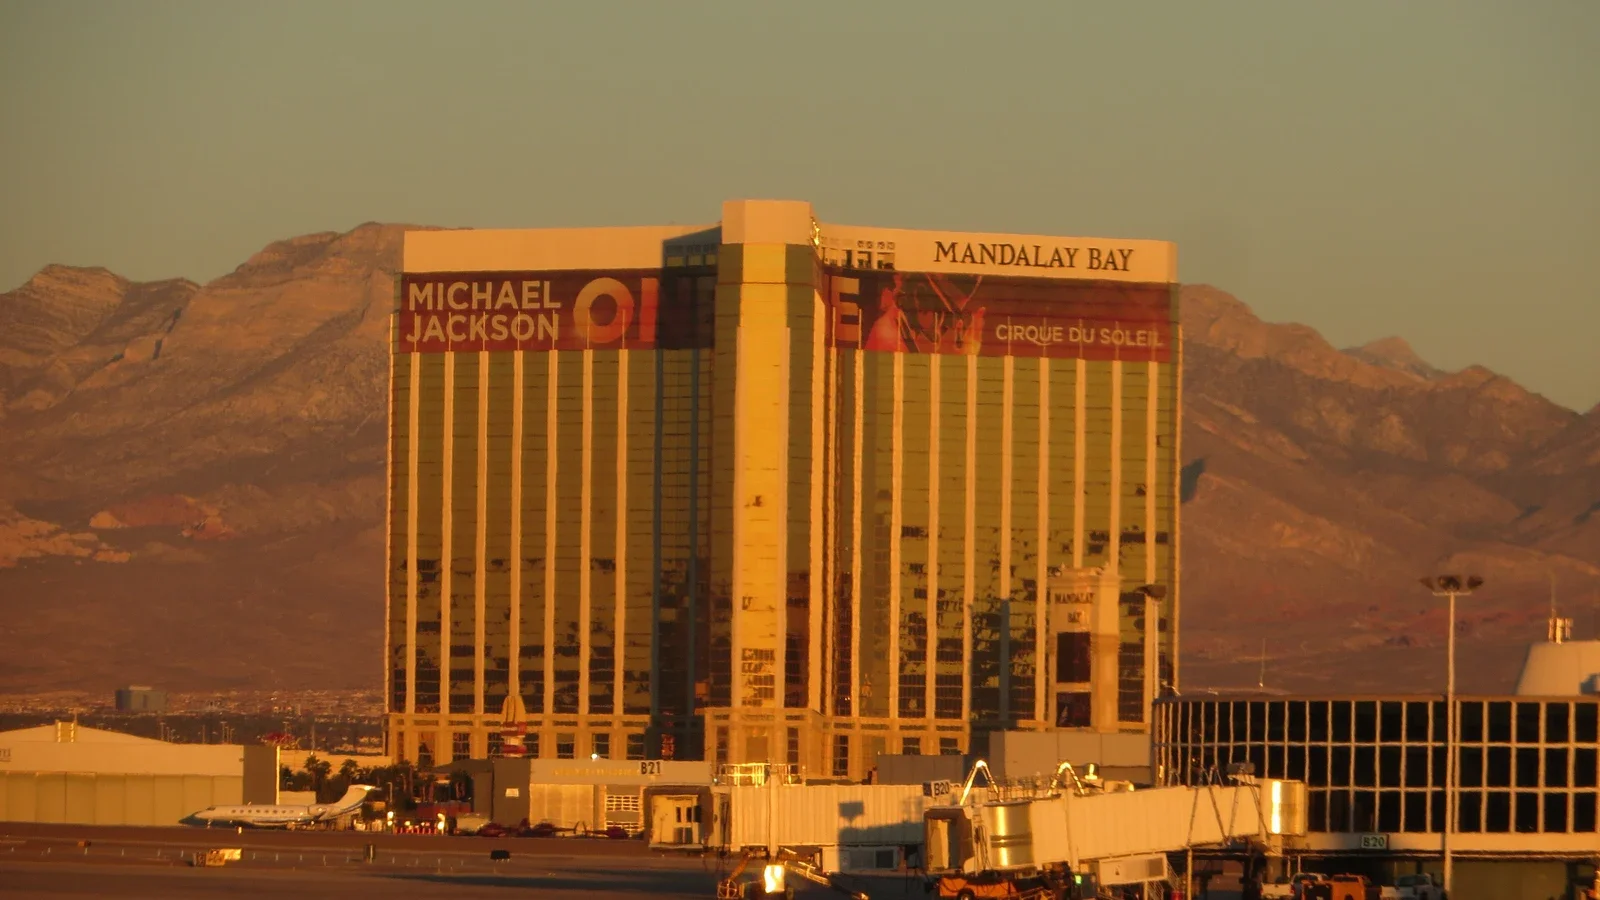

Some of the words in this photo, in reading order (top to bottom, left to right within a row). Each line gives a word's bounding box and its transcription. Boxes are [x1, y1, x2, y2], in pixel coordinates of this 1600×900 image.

[934, 241, 1079, 269] MANDALAY
[1087, 247, 1134, 271] BAY
[408, 280, 561, 311] MICHAEL
[406, 313, 560, 343] JACKSON
[996, 324, 1063, 346] CIRQUE
[1069, 327, 1095, 343] DU
[1101, 328, 1163, 347] SOLEIL
[640, 760, 661, 775] B21
[934, 781, 950, 796] B20
[1362, 836, 1385, 848] B20
